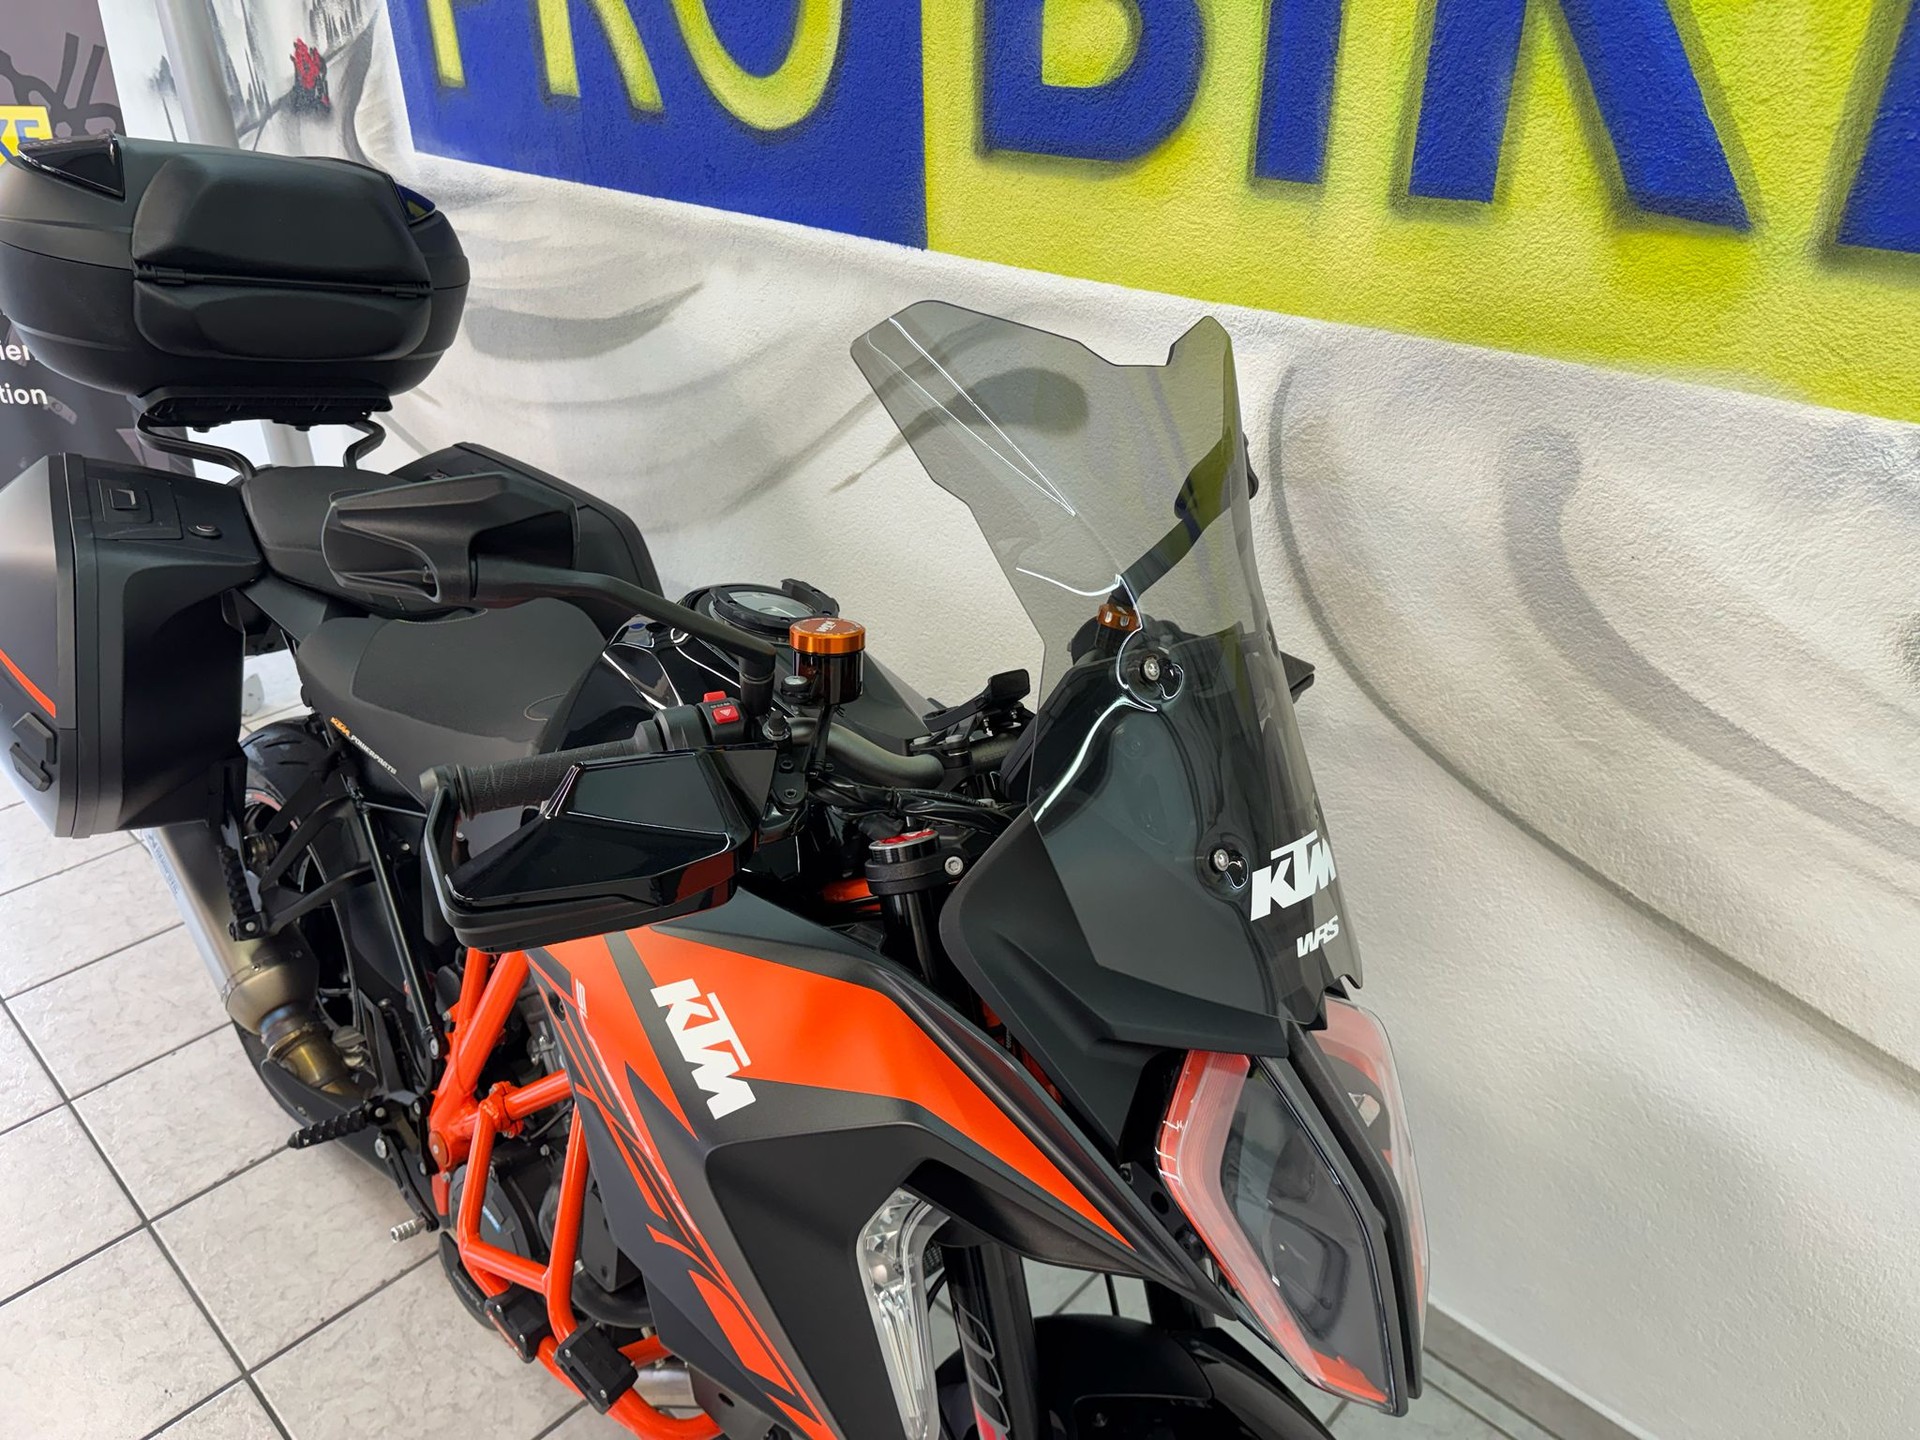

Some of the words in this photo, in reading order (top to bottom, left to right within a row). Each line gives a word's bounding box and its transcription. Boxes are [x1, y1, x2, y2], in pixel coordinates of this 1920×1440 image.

[0, 382, 48, 405] tion
[1250, 829, 1337, 921] KTM
[1296, 914, 1339, 958] WRS
[650, 978, 756, 1120] KTM
